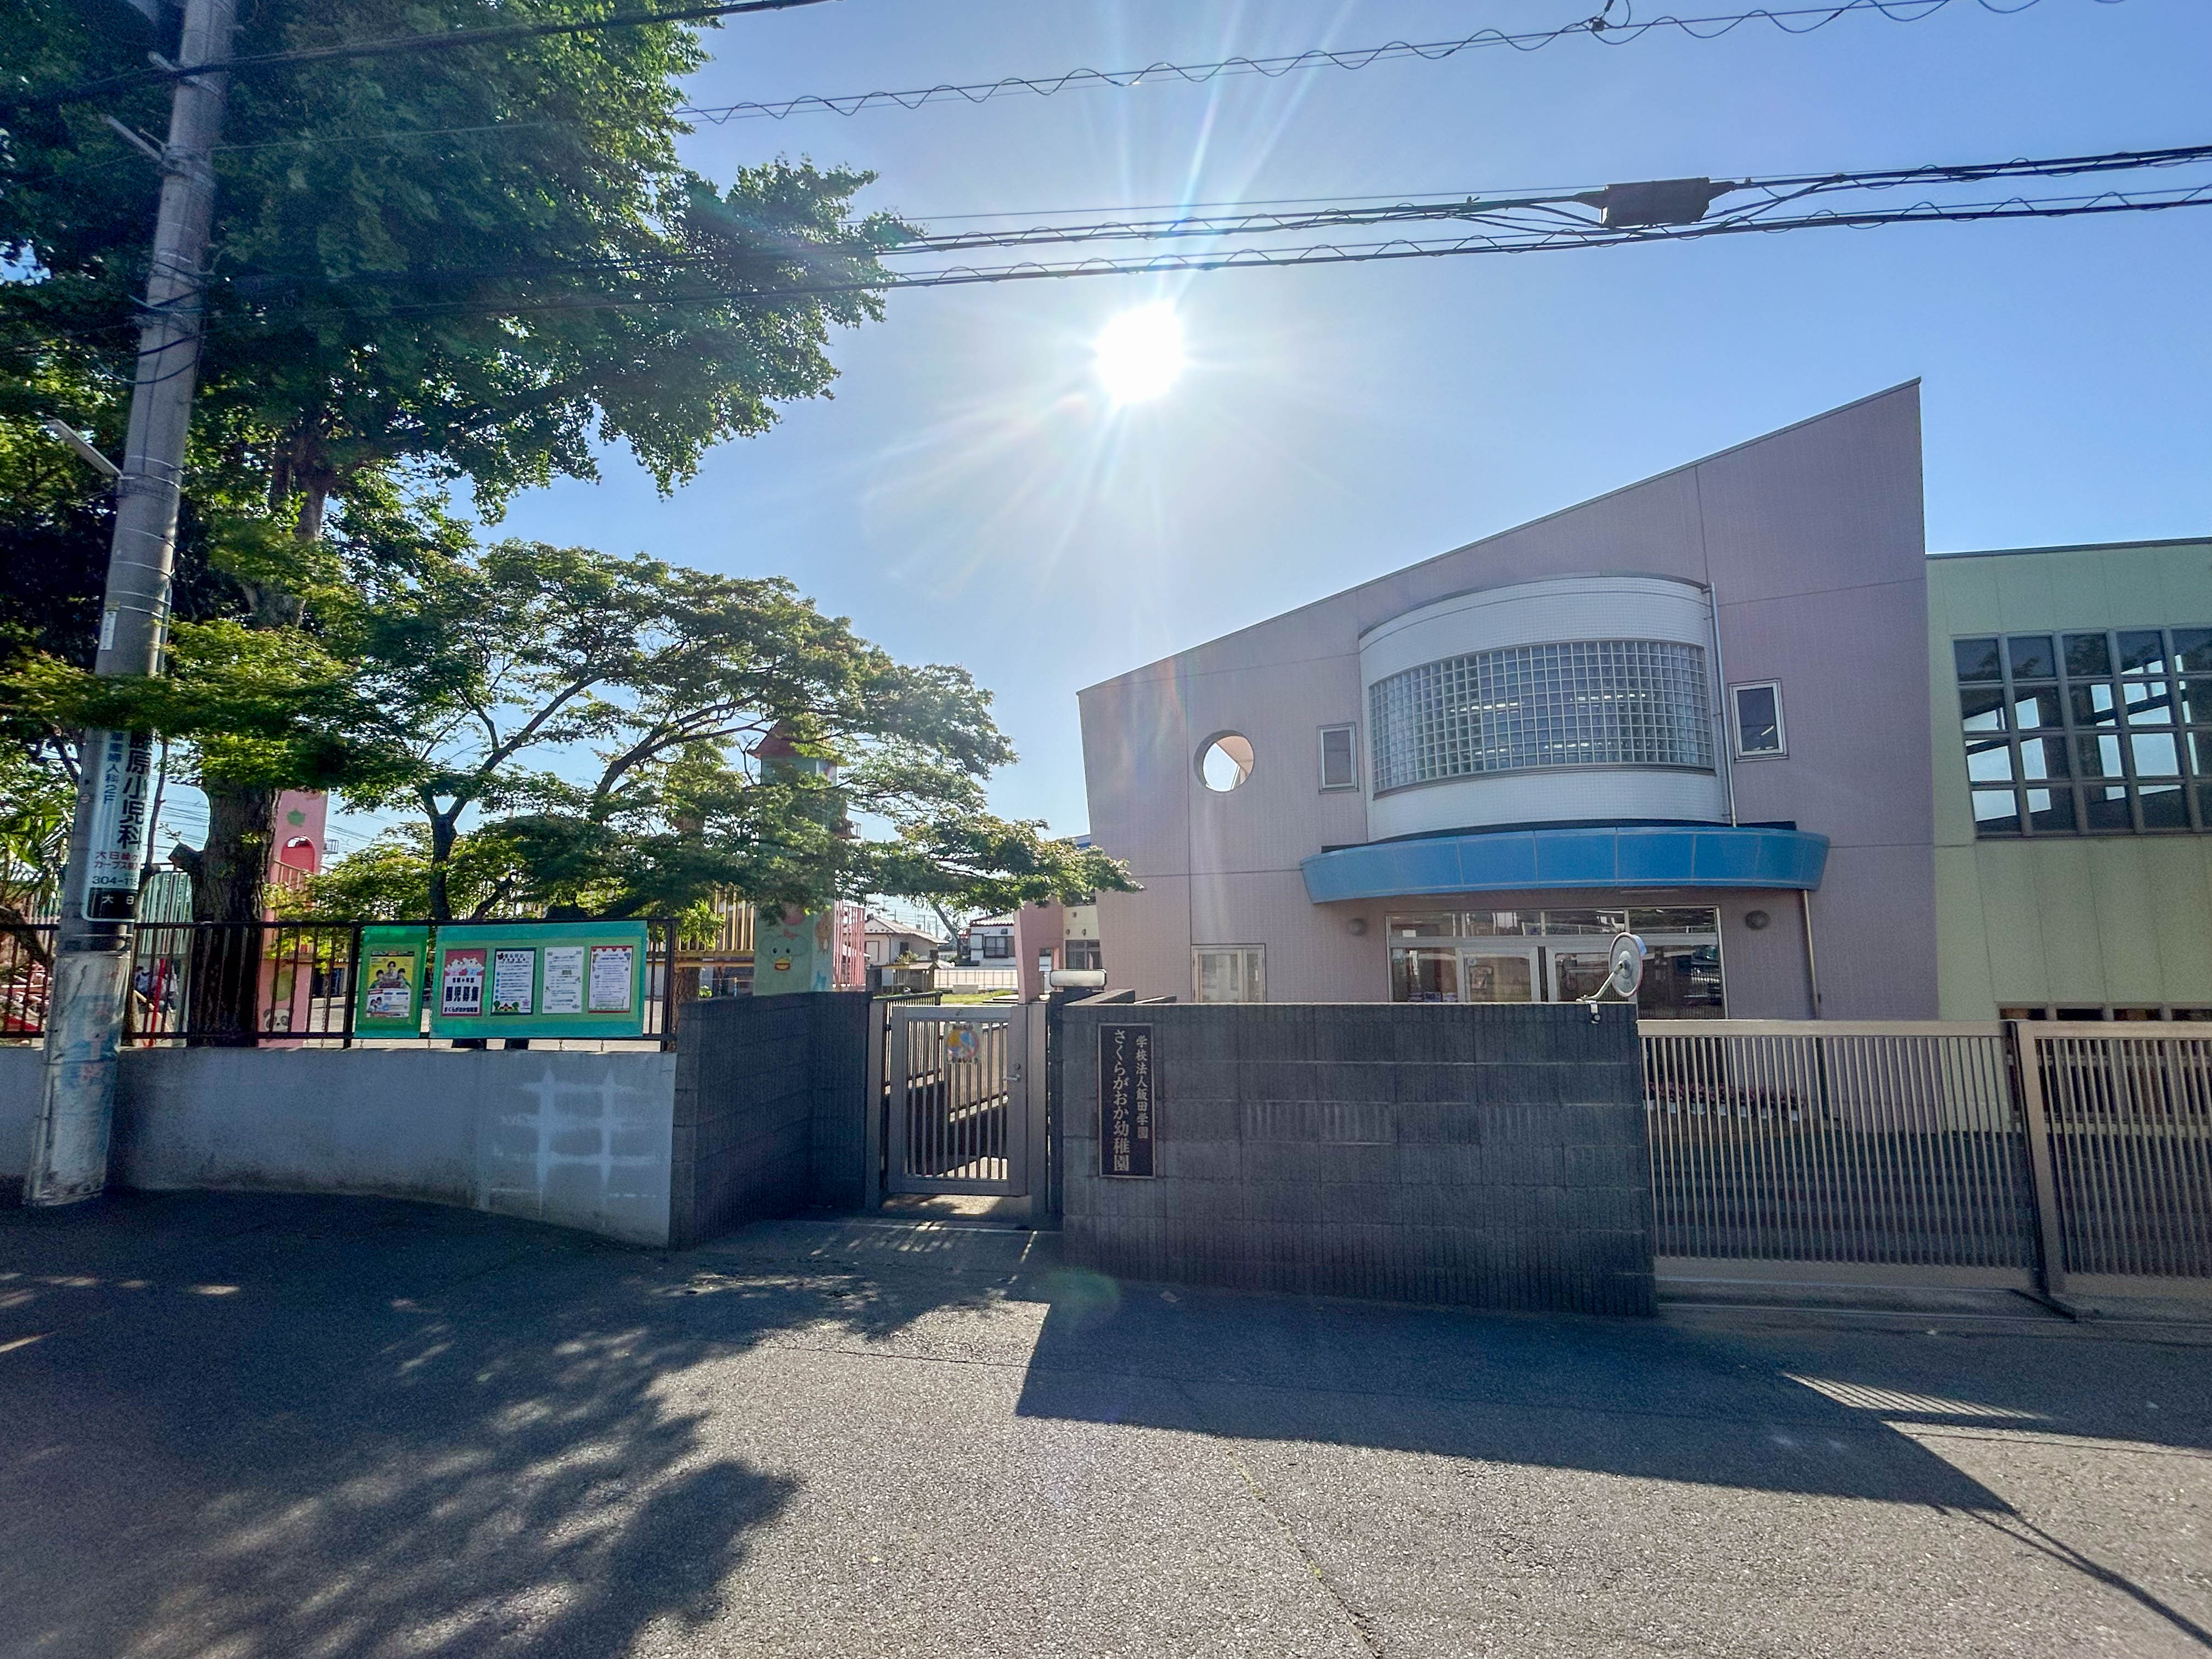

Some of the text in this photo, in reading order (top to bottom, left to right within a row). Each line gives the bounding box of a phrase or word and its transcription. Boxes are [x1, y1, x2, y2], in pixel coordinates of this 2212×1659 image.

[445, 986, 479, 1002] 園児募集
[1113, 1029, 1130, 1172] さくらがおか幼稚園
[1135, 1035, 1149, 1139] 学校法人飯田学園
